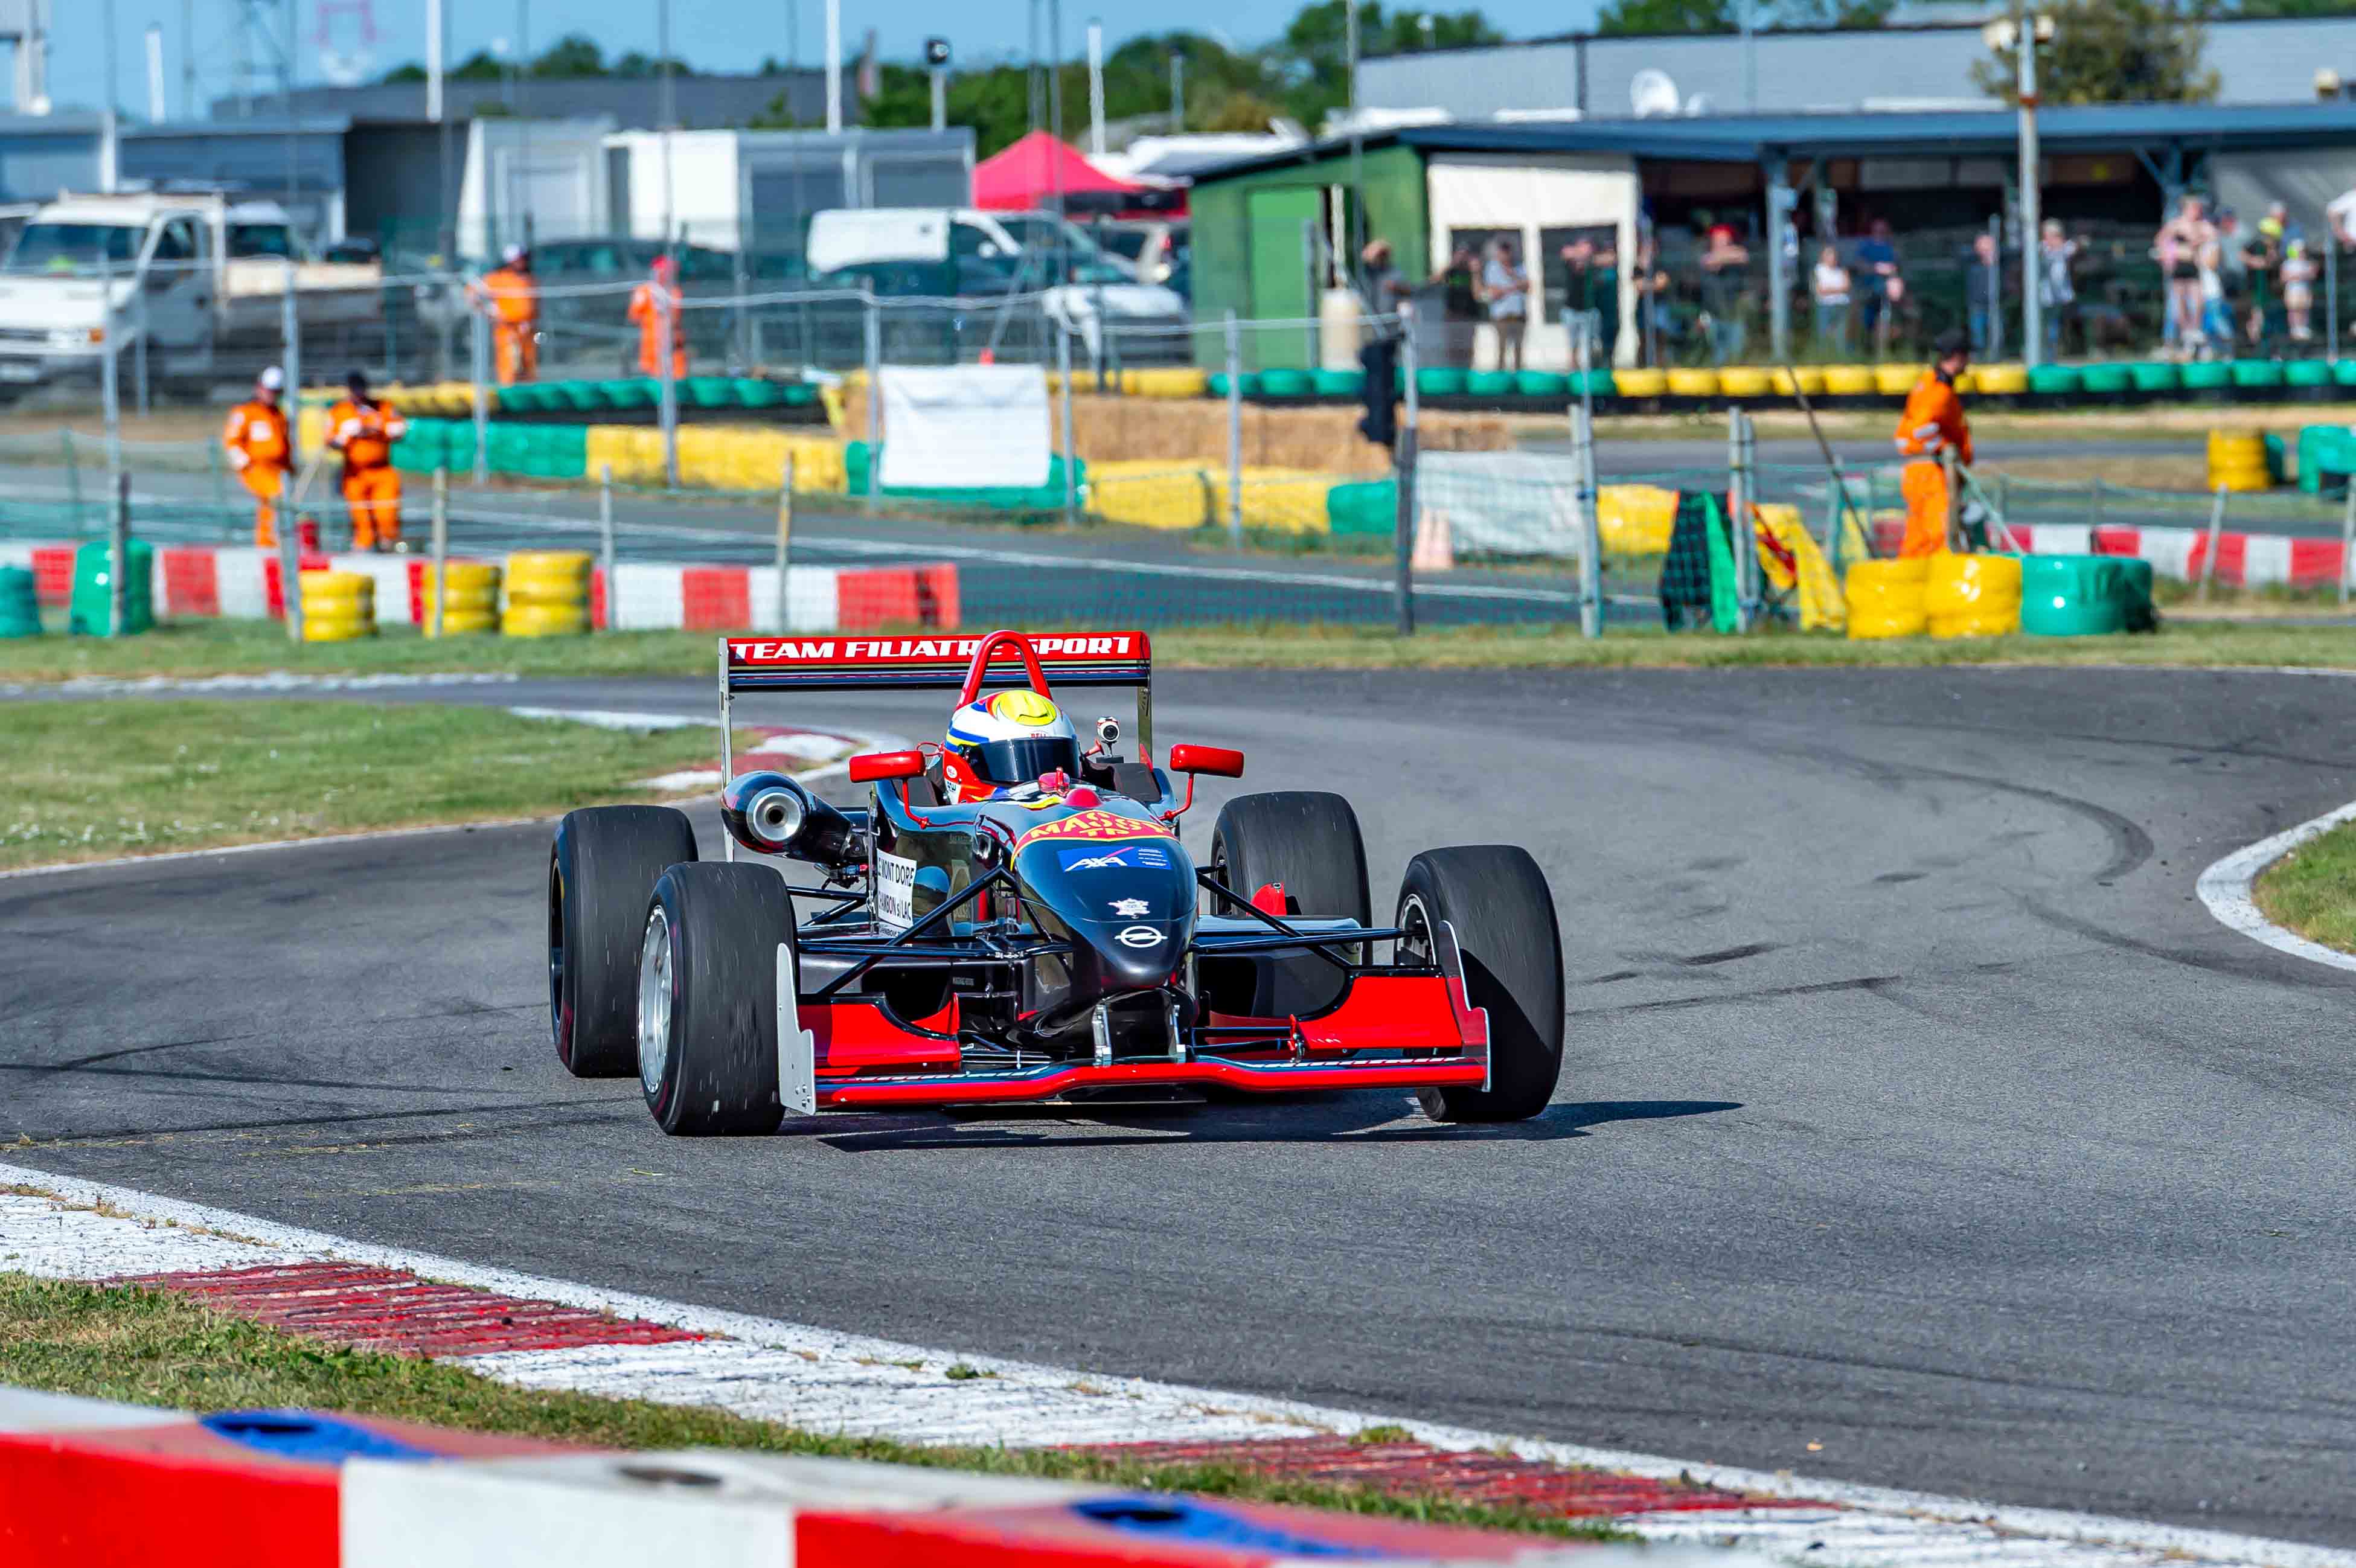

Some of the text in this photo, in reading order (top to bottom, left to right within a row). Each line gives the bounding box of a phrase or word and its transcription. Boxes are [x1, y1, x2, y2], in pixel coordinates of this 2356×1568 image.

[728, 642, 834, 659] TEAM
[1029, 812, 1168, 838] MASSY
[1079, 828, 1129, 836] TP
[1064, 856, 1128, 872] AXA
[895, 863, 914, 886] DORE
